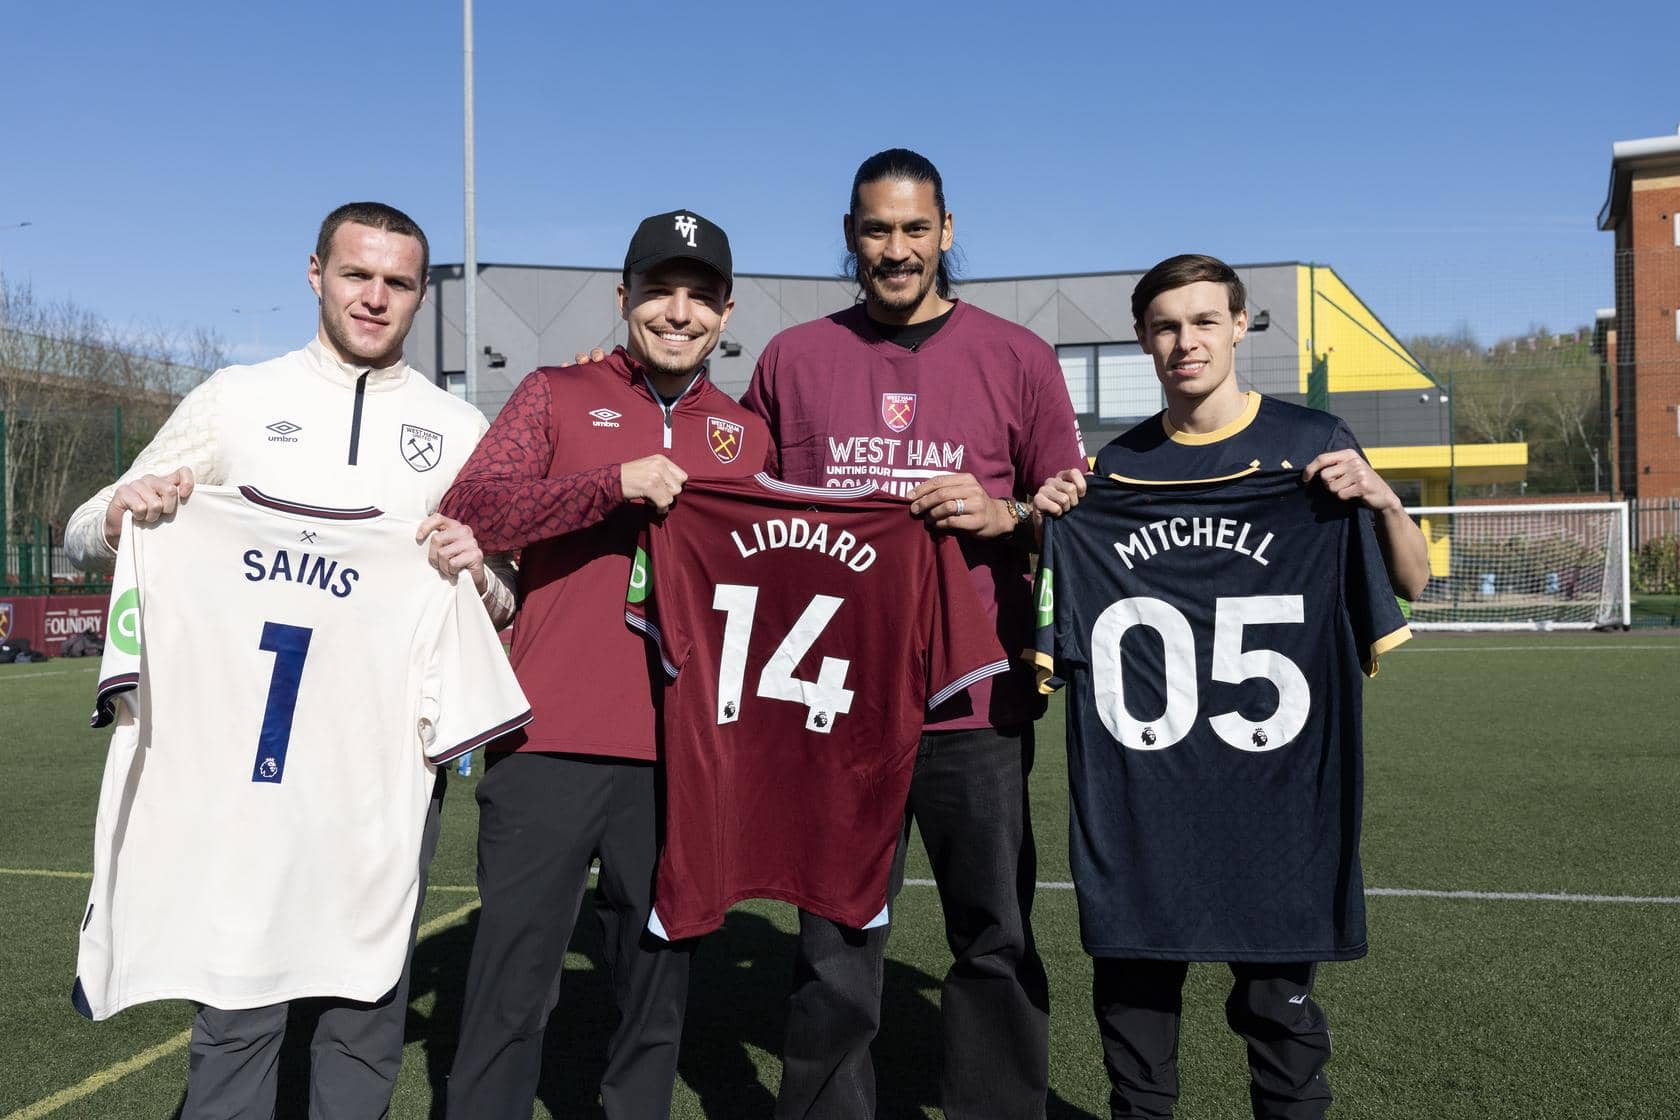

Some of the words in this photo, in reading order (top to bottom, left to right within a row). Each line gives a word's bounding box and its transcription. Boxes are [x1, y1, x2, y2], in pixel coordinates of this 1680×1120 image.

[268, 435, 298, 443] umbro
[592, 420, 620, 428] umbro
[826, 466, 867, 475] UNITING
[868, 466, 891, 477] OUR
[828, 436, 902, 466] WEST
[907, 439, 965, 470] HAM
[731, 518, 877, 573] LIDDARD
[1113, 517, 1276, 570] MITCHELL
[243, 549, 360, 598] SAINS
[44, 616, 102, 635] FOUNDRY
[712, 583, 855, 734] 14
[1090, 594, 1311, 752] 05
[251, 621, 314, 784] 1
